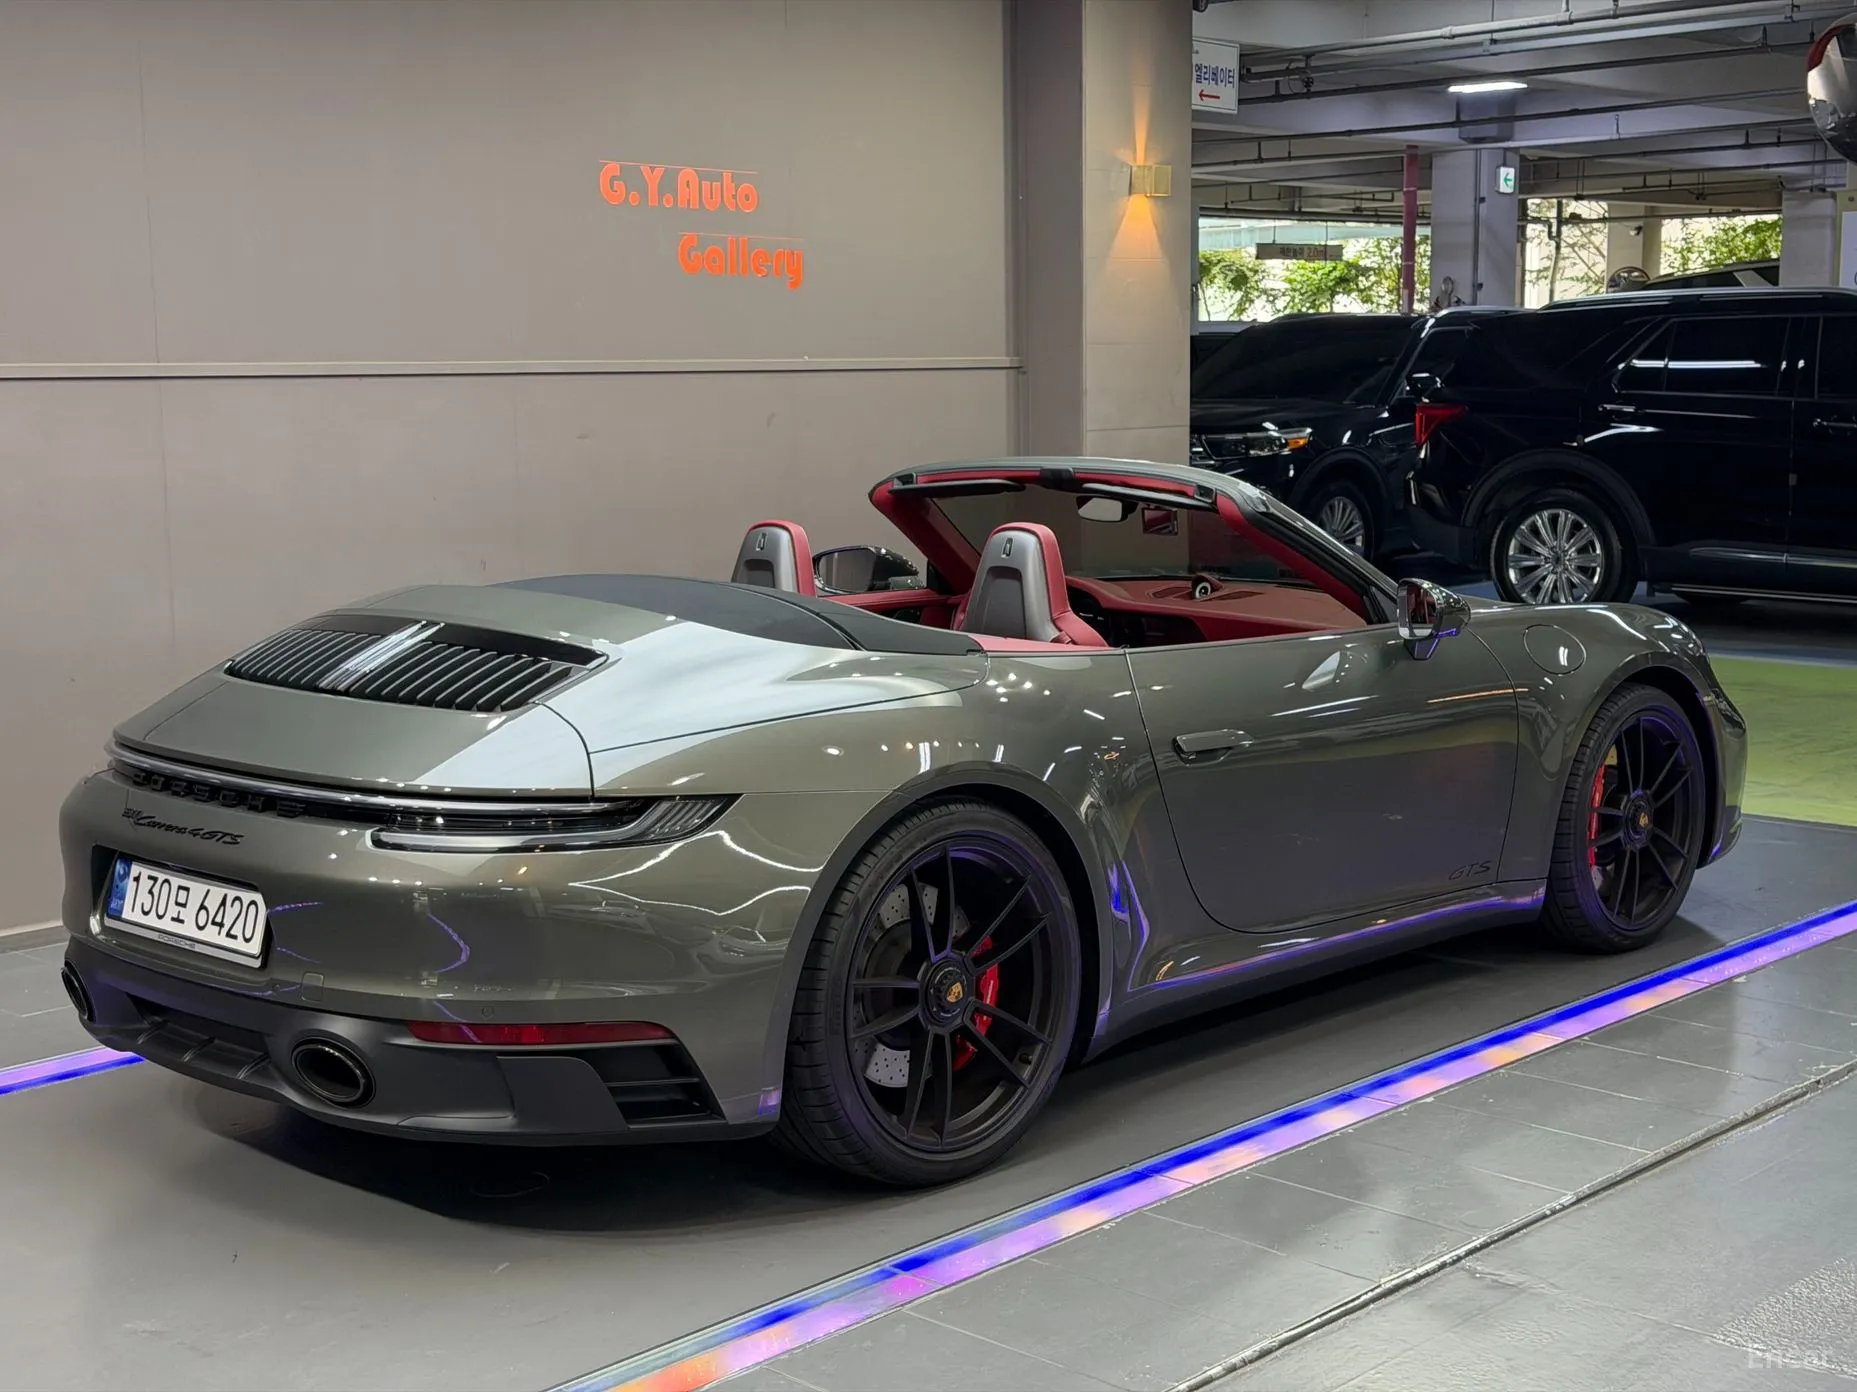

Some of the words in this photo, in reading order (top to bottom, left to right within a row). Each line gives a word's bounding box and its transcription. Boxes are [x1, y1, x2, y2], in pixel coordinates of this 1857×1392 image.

[1195, 63, 1235, 89] 엘리베이터
[599, 162, 759, 213] G.Y.Auto
[677, 233, 804, 291] Gallery
[200, 830, 245, 845] GTS
[1448, 860, 1492, 881] GTS
[131, 871, 190, 925] 130모
[195, 888, 259, 944] 6420
